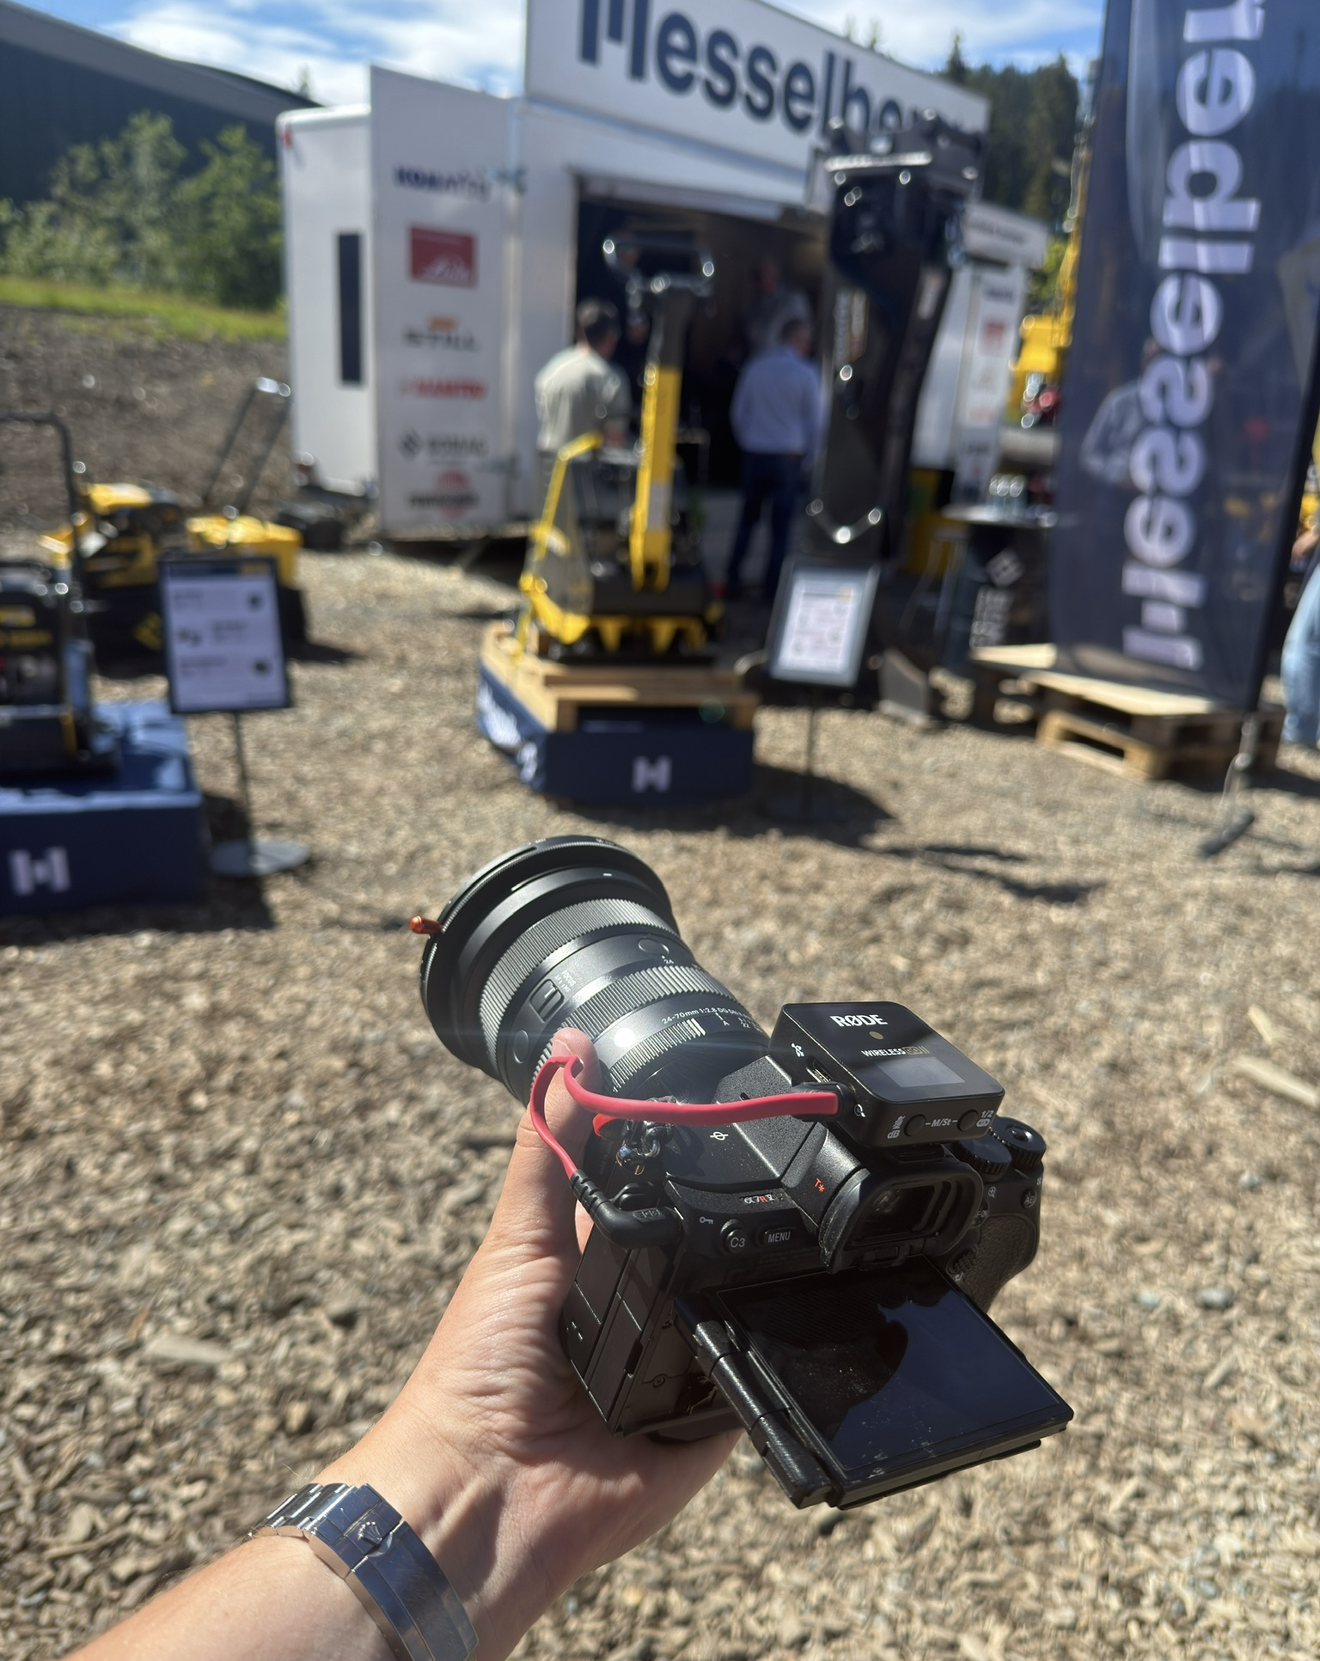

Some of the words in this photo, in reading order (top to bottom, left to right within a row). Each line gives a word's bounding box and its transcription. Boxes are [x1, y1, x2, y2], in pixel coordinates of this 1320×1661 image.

[578, 0, 920, 142] Hesselbe
[661, 1009, 700, 1025] 24-70mm
[829, 1014, 888, 1027] RØDE
[861, 1047, 905, 1057] WIRELESS
[981, 1110, 994, 1118] 1/2
[887, 1129, 901, 1139] dB
[730, 1237, 746, 1248] C3
[767, 1231, 791, 1243] MENU
